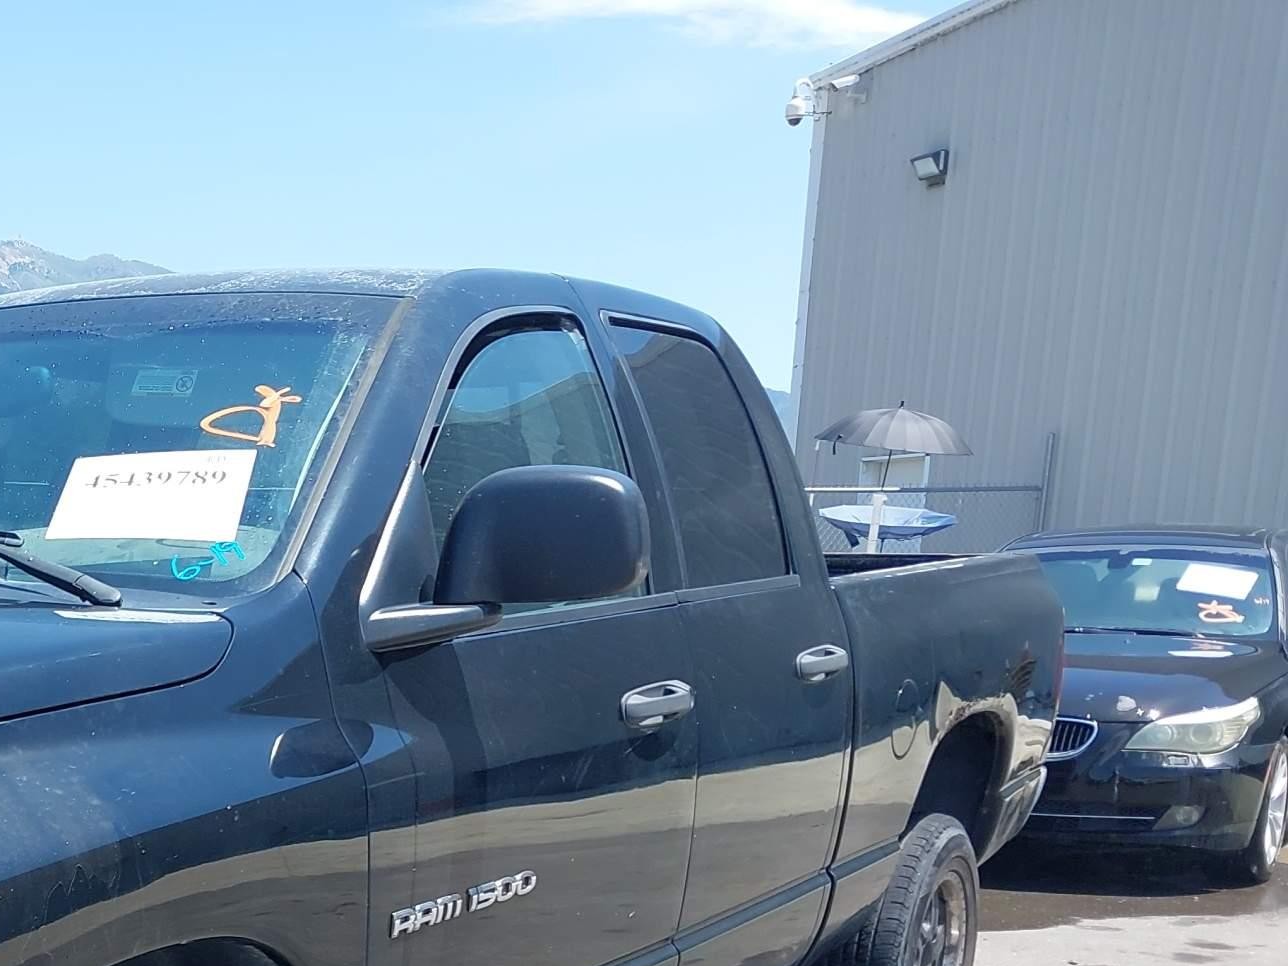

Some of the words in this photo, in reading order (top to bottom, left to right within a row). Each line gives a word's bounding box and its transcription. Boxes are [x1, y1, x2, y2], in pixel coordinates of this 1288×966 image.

[85, 471, 227, 488] 45439789
[389, 893, 462, 939] RAM
[466, 870, 537, 913] 1500
